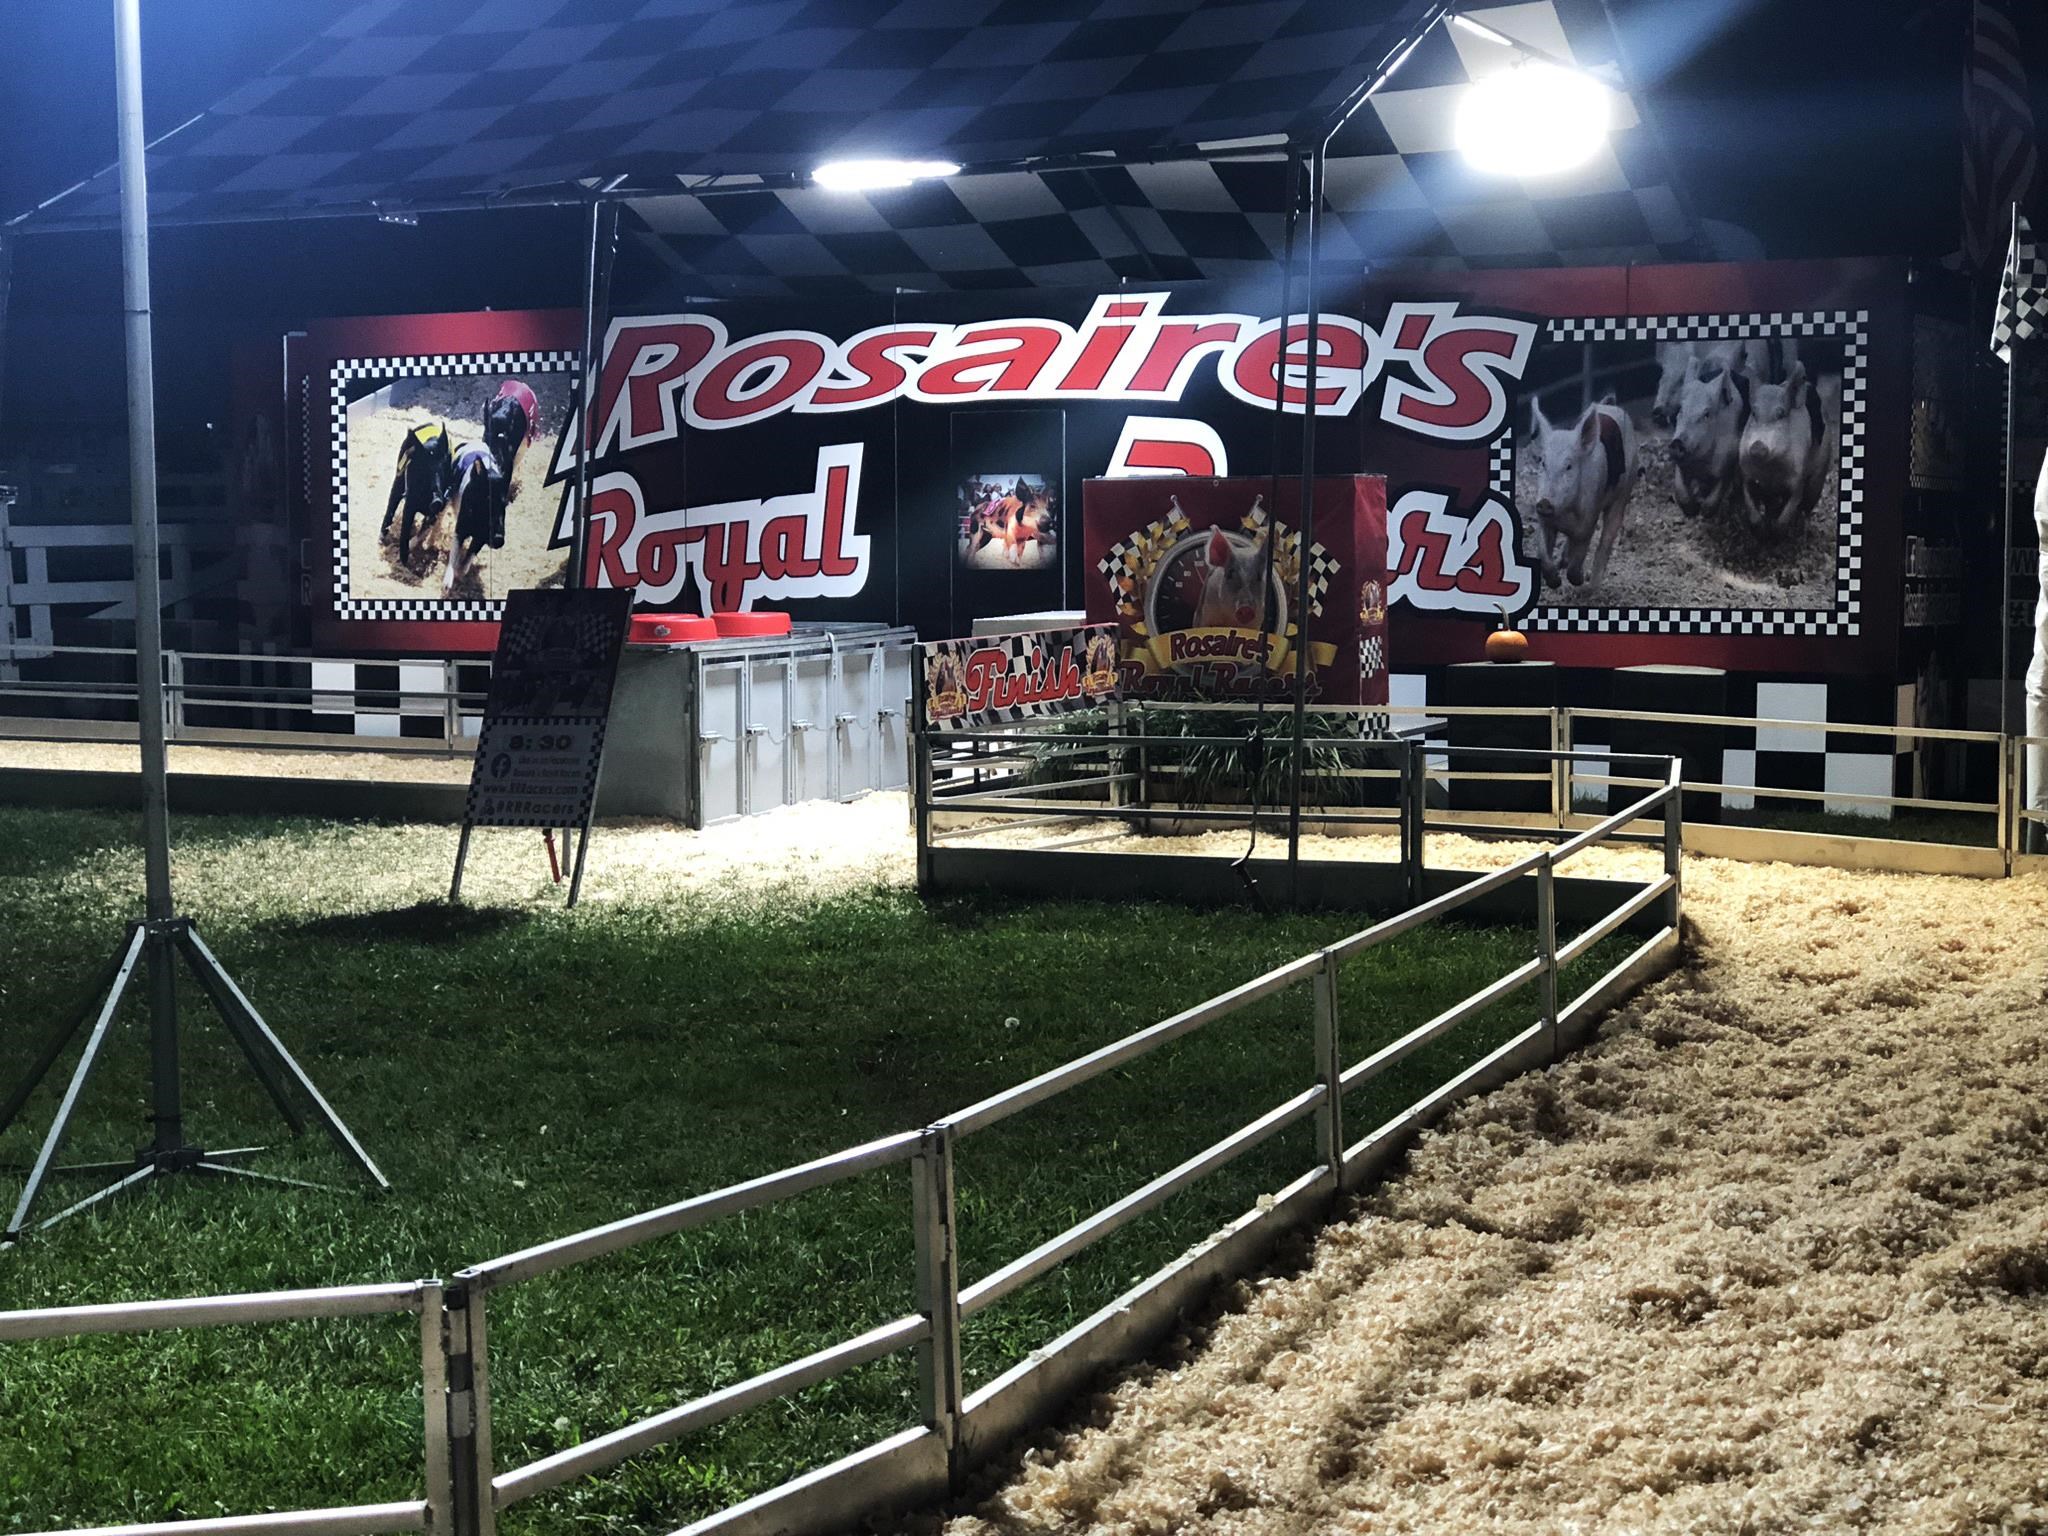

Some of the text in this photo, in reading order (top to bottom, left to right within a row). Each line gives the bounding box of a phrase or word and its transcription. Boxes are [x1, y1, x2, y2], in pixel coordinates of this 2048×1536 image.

[557, 293, 1535, 473] Rosaire's
[570, 449, 869, 616] Royal
[965, 645, 1082, 714] Finish
